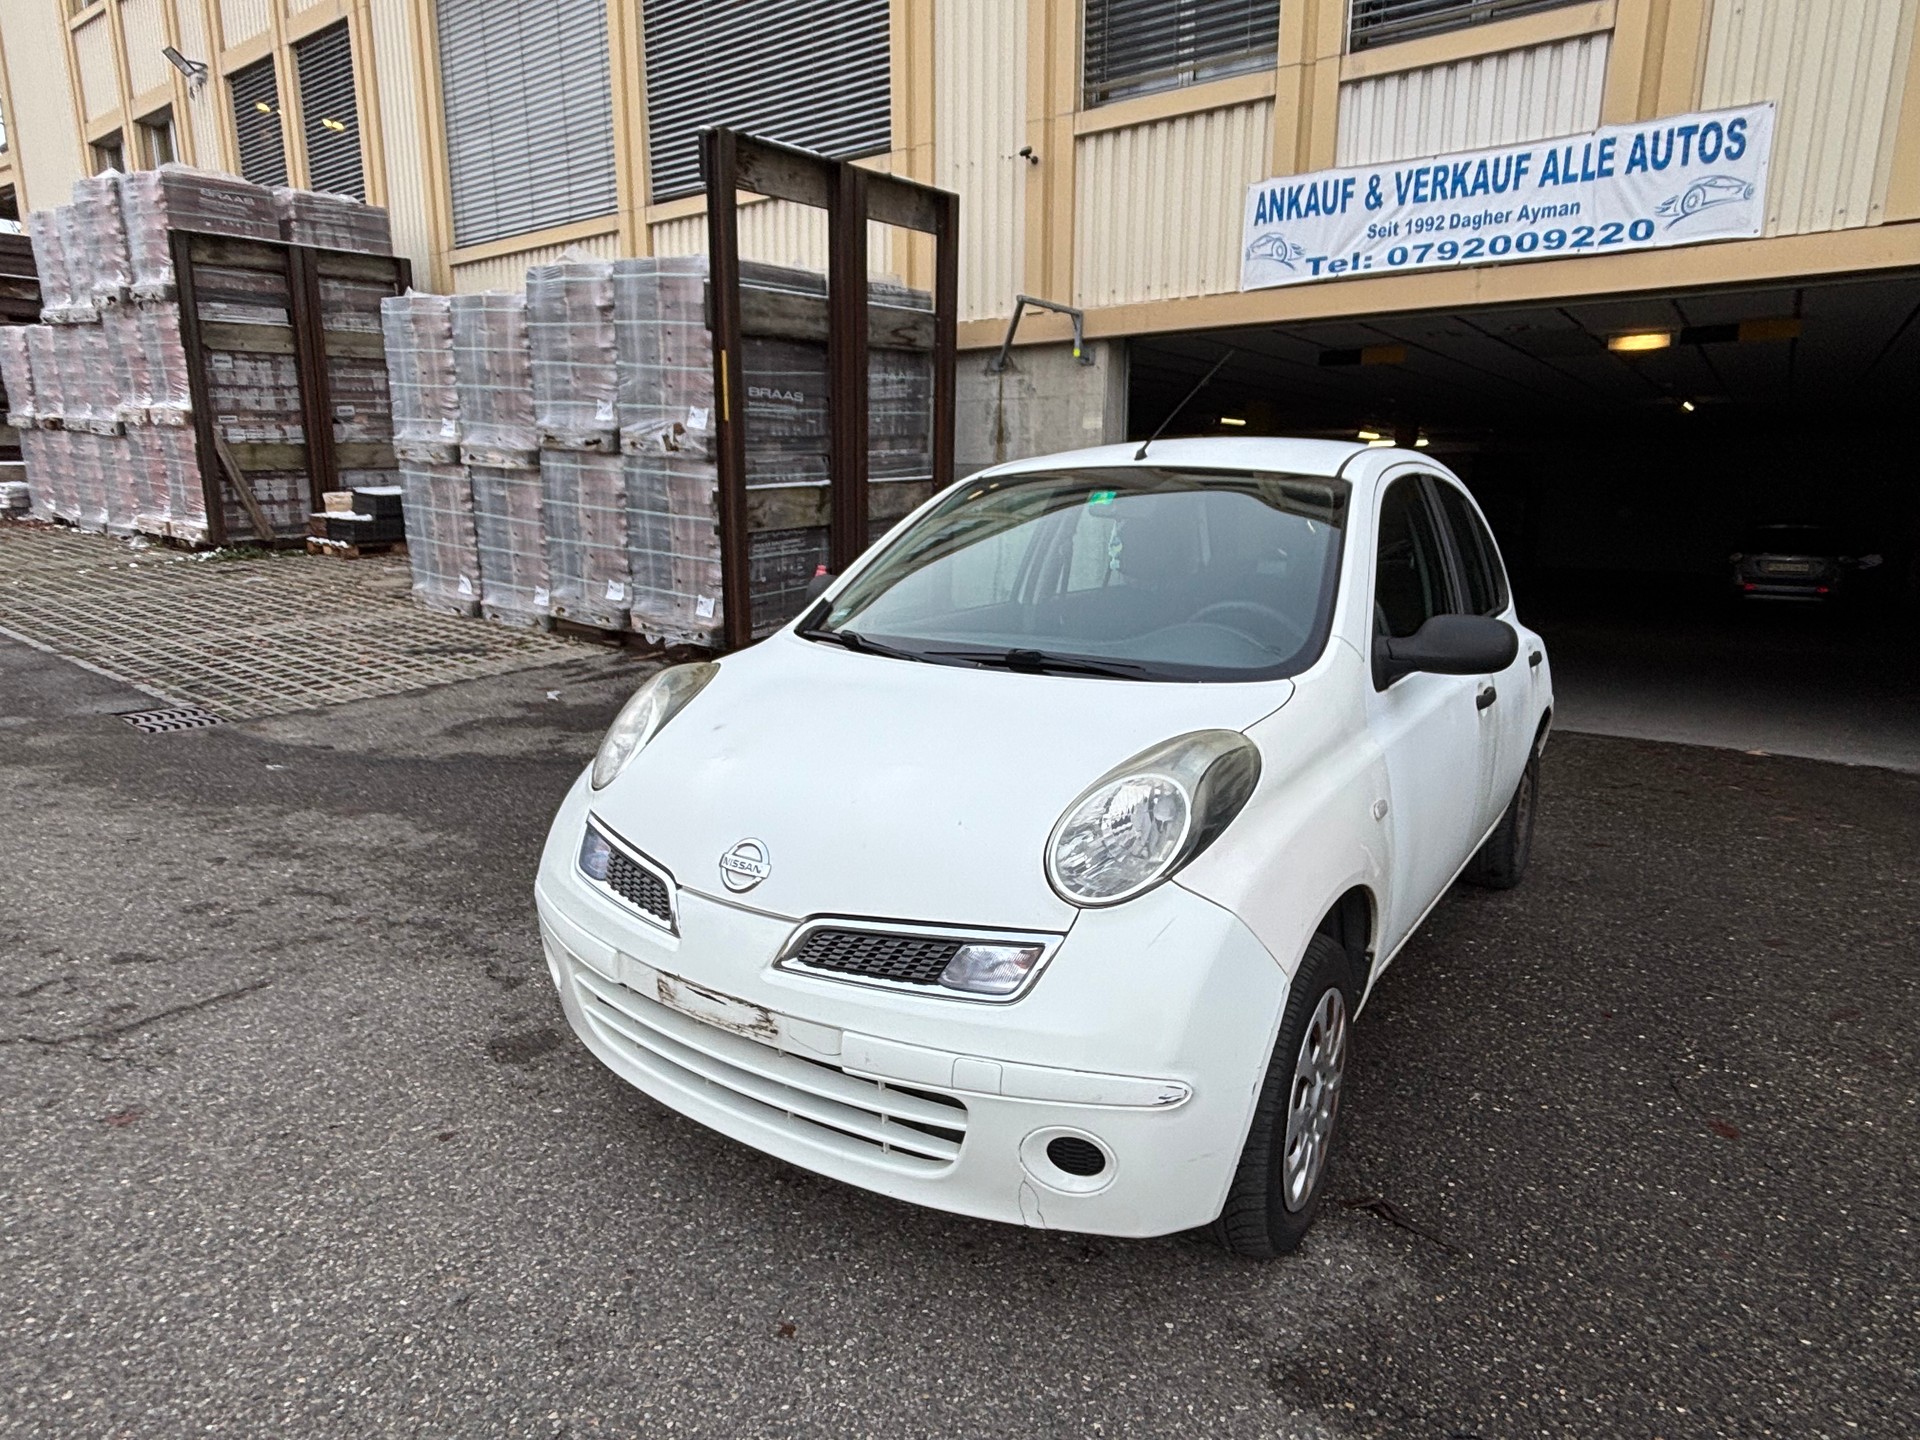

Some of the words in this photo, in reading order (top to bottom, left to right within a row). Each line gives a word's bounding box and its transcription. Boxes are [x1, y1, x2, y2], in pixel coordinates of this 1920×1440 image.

[1254, 177, 1356, 226] ANKAUF
[1365, 174, 1383, 211] &
[1395, 152, 1532, 206] VERKAUF
[1538, 136, 1617, 188] ALLE
[1625, 117, 1748, 175] AUTOS
[1367, 220, 1399, 239] Seit
[1405, 213, 1445, 235] 1992
[1449, 208, 1512, 230] Dagher
[1517, 201, 1581, 224] Ayman
[1306, 252, 1373, 275] Tel:
[1387, 218, 1655, 266] 0792009220
[748, 386, 804, 402] BRAAS
[723, 856, 761, 874] NISSAN
